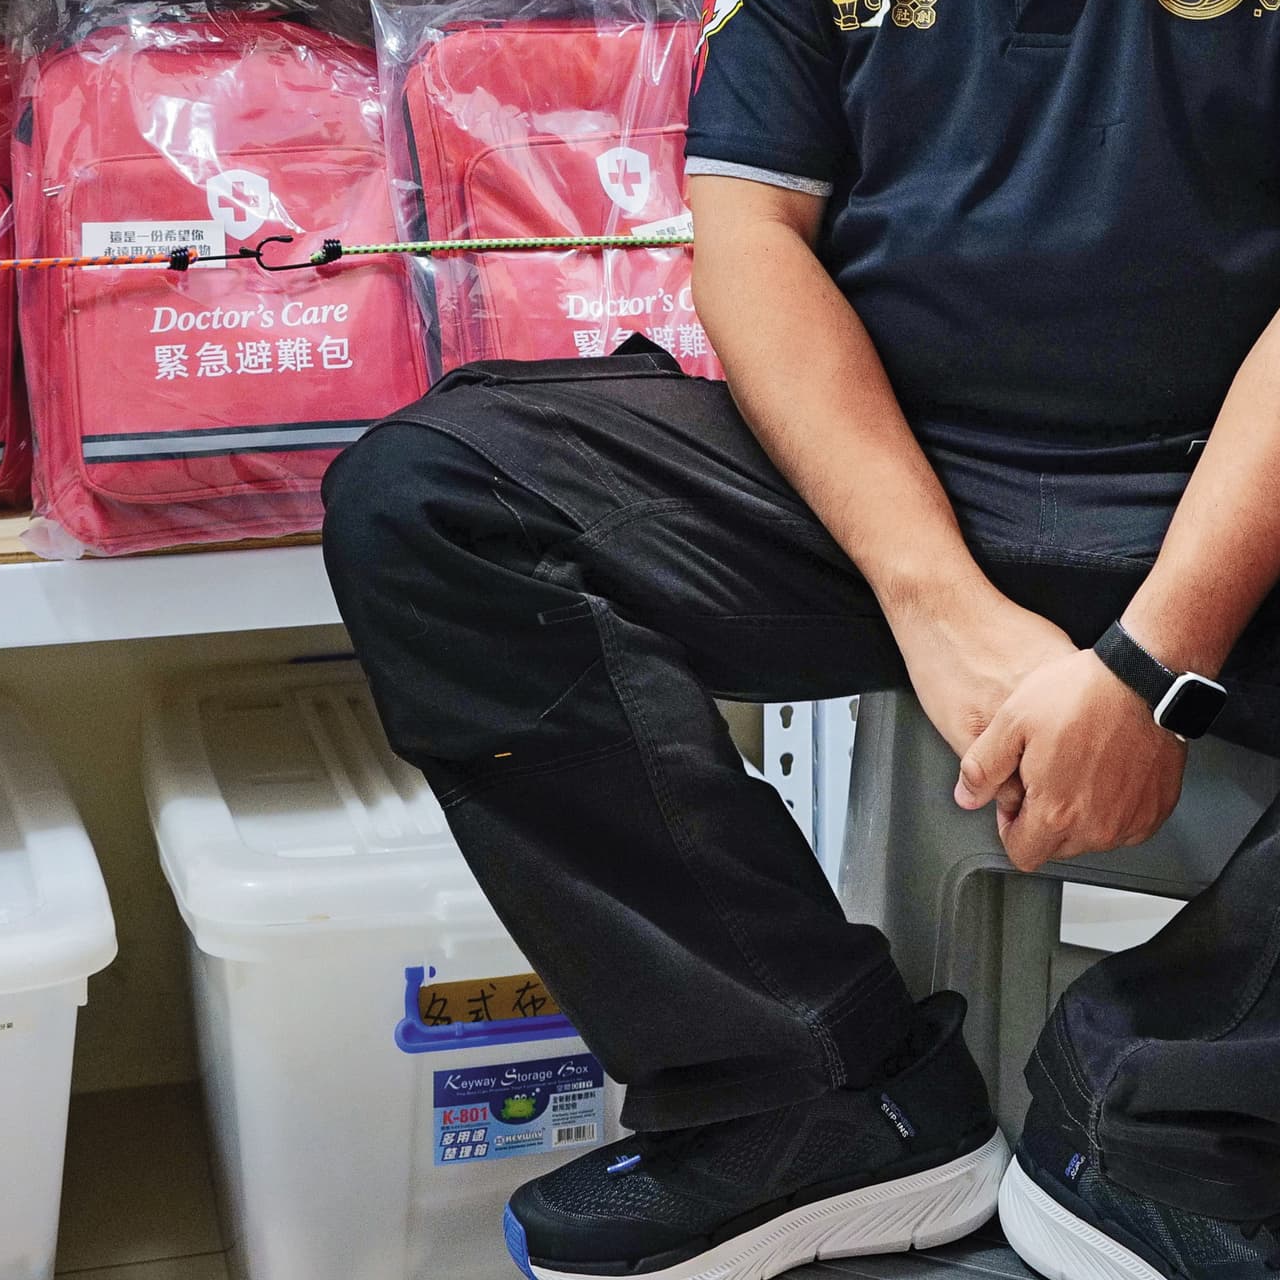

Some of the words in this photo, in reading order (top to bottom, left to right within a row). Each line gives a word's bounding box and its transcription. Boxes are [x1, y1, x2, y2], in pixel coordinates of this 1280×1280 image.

[110, 230, 204, 243] 這是一份希望你
[150, 304, 274, 333] Doctor's
[281, 302, 349, 326] Care
[566, 288, 673, 319] Doctor's
[154, 335, 353, 380] 緊急避難包
[444, 1074, 497, 1091] Keyway
[501, 1067, 553, 1087] Storage
[557, 1061, 588, 1078] Box
[442, 1107, 489, 1125] K-801
